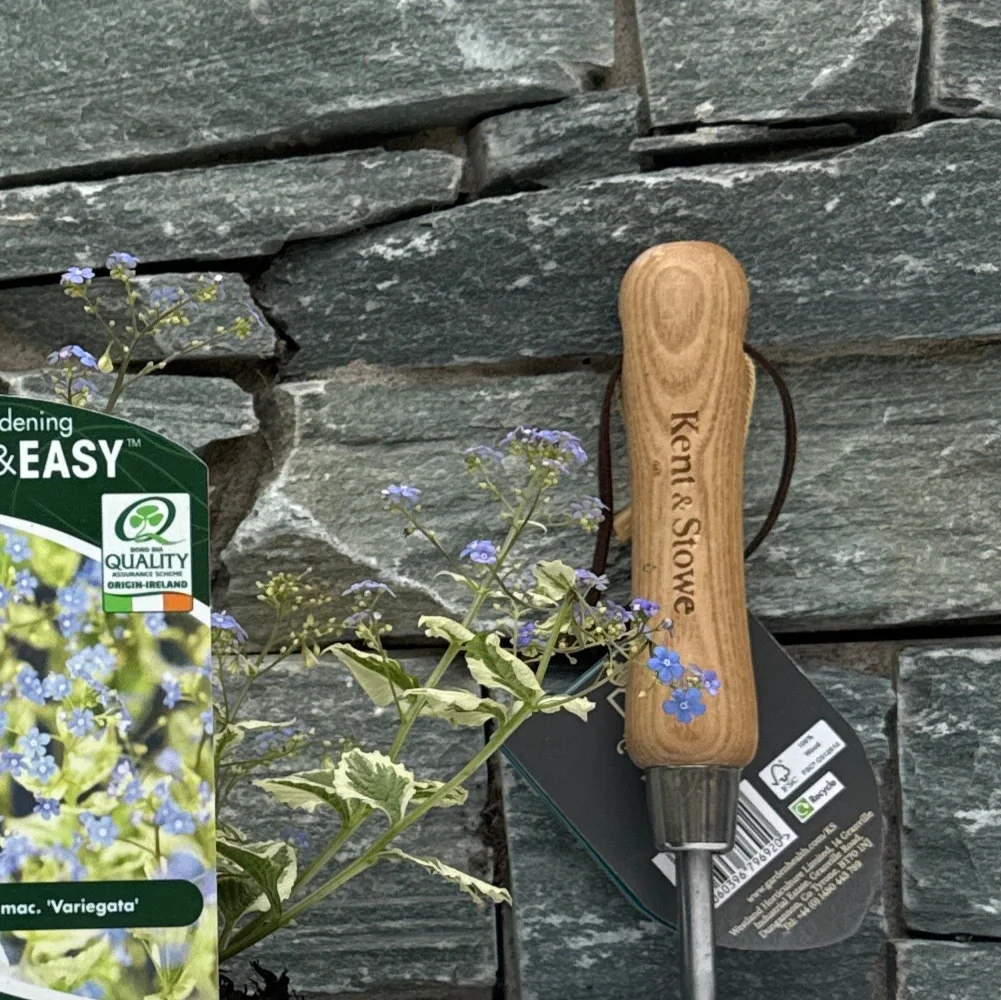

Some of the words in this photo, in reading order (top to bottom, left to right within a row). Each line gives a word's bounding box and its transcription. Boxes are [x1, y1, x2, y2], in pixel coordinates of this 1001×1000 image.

[670, 410, 699, 486] Kent
[672, 492, 693, 511] &
[105, 553, 189, 570] QUALITY
[672, 517, 701, 616] Stowe
[808, 780, 836, 803] Recycle
[1, 901, 42, 915] mac.
[47, 897, 139, 917] 'Variegata'
